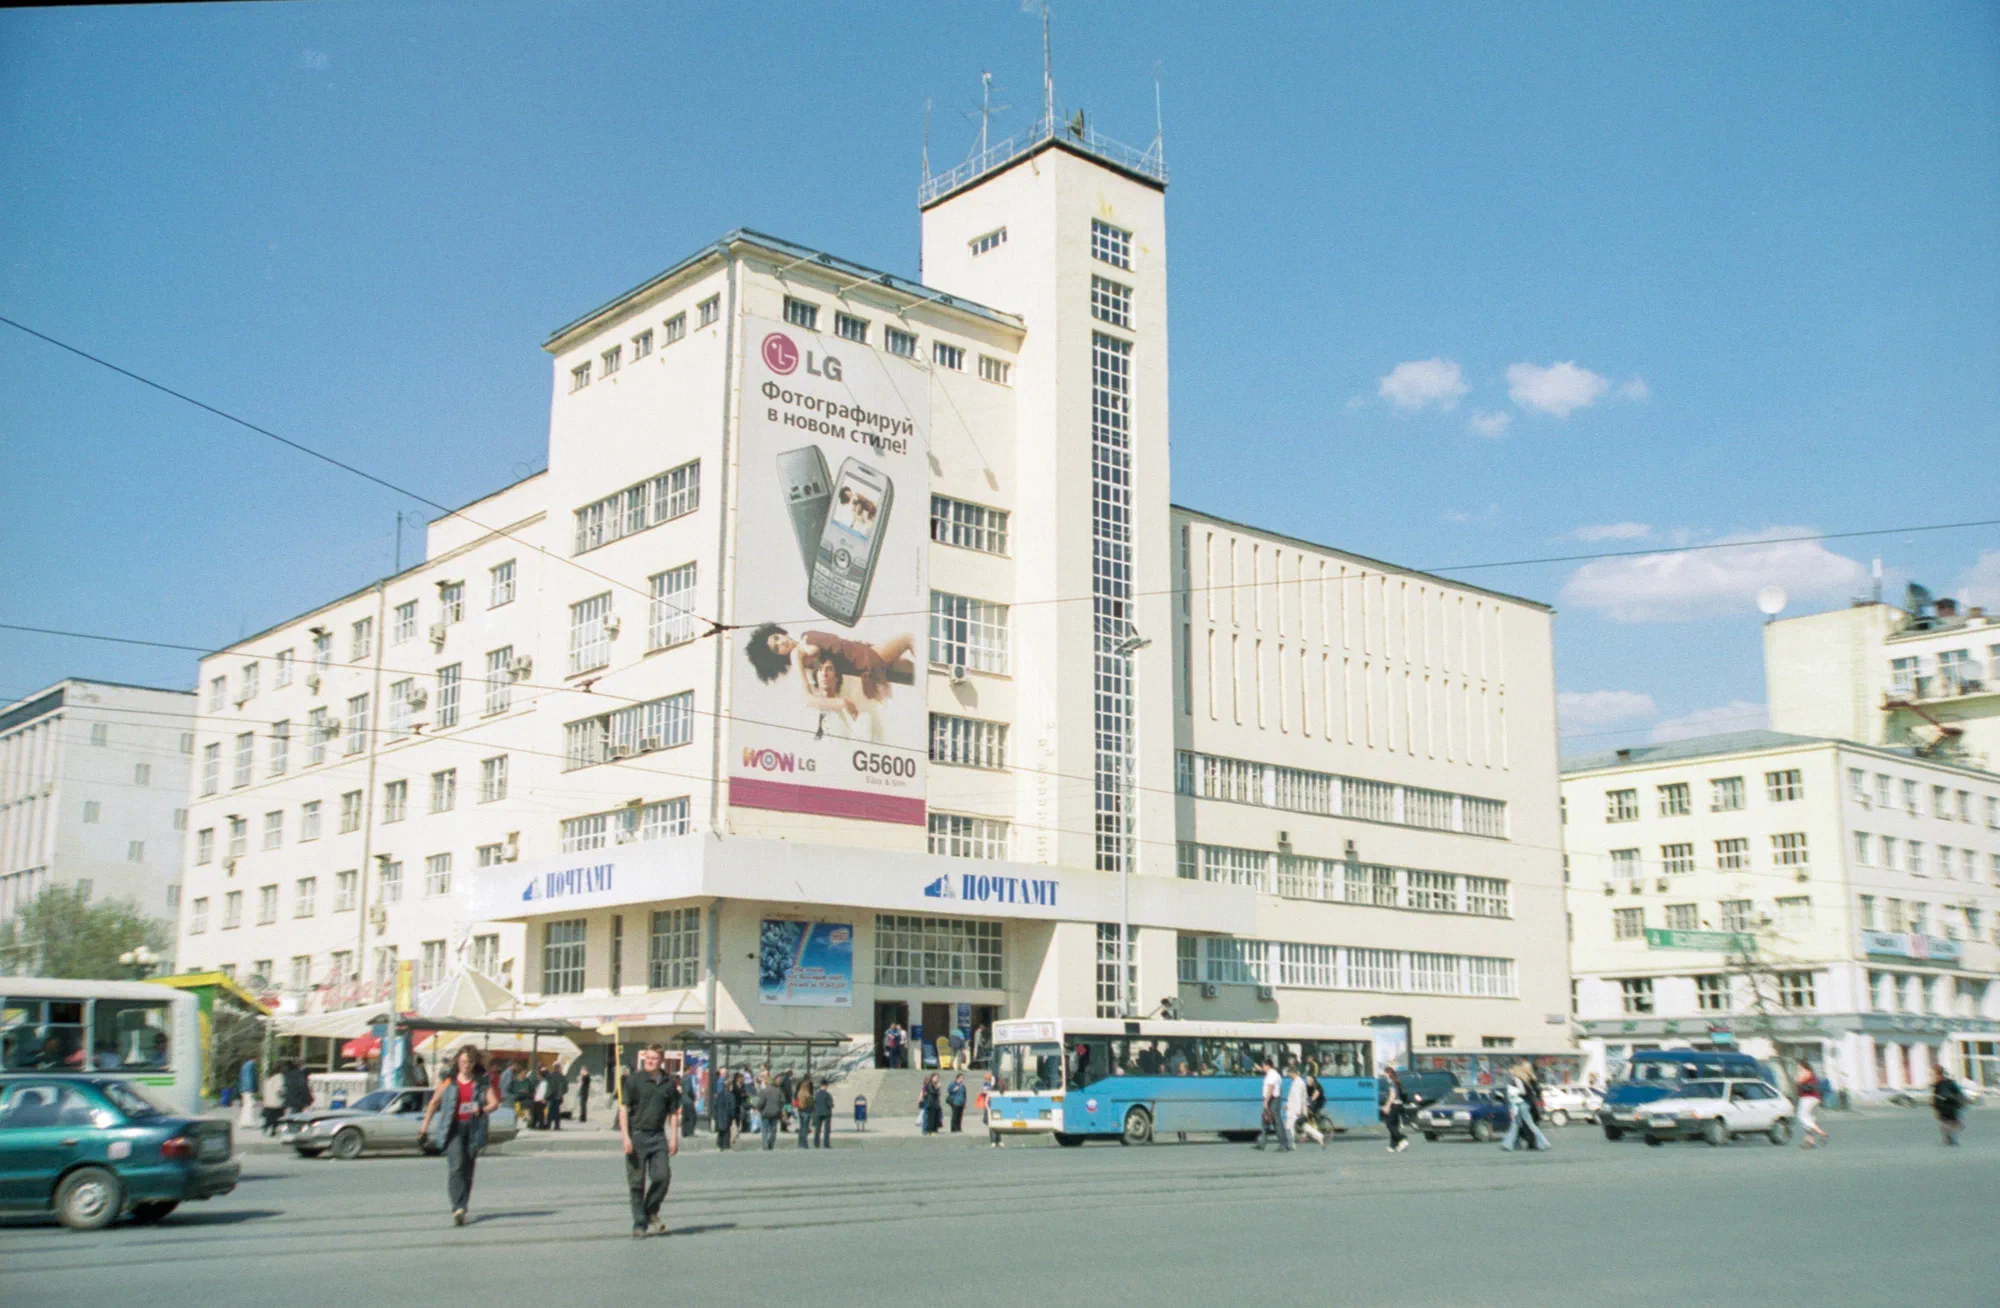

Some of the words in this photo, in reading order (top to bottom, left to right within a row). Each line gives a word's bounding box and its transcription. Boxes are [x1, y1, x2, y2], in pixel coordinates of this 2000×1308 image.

[806, 350, 843, 382] LG
[761, 380, 914, 437] Фотографируй
[767, 408, 778, 422] в
[783, 412, 846, 439] новом
[850, 428, 907, 455] стиле!
[742, 746, 795, 773] WOW
[798, 757, 816, 772] LG
[852, 750, 916, 778] G5600
[546, 863, 615, 899] ПОЧТАМТ
[962, 873, 1060, 906] ПОЧТАМТ
